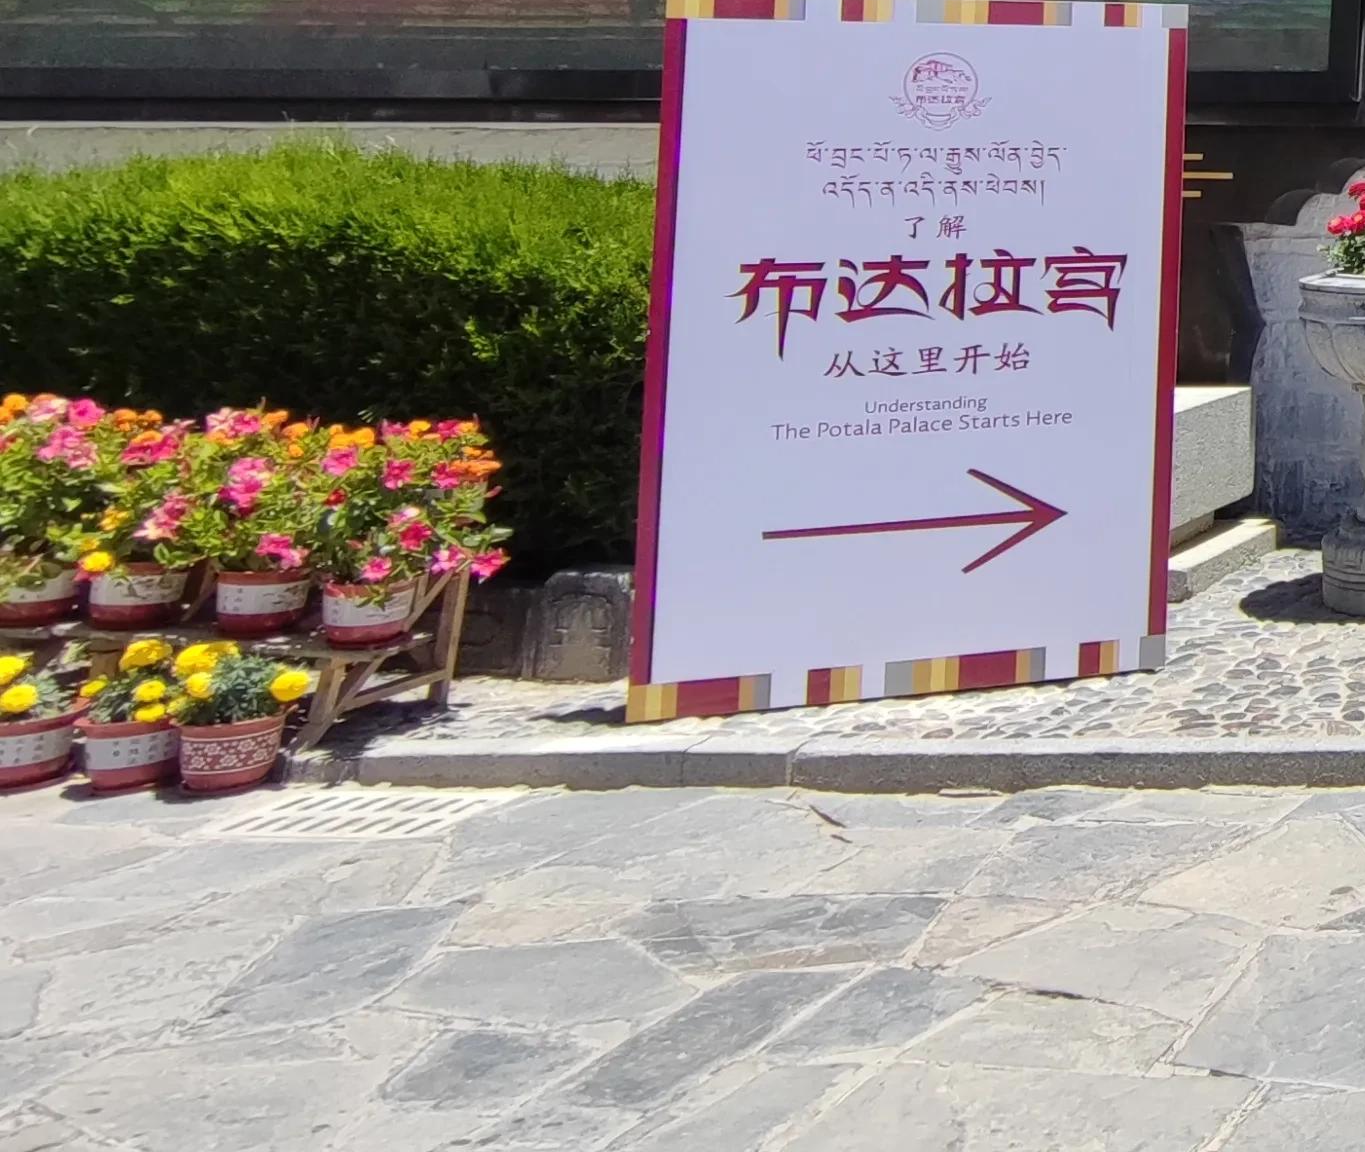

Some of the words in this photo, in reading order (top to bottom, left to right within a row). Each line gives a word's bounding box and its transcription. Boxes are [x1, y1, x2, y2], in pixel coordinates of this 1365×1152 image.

[904, 214, 968, 240] 了解
[725, 245, 1129, 360] 布达拉宫
[823, 341, 1031, 378] 从这里开始
[864, 396, 989, 415] Understanding
[771, 423, 811, 441] The
[817, 418, 882, 438] Potala
[888, 415, 953, 435] Palace
[959, 413, 1020, 431] Starts
[1026, 410, 1073, 427] Here
